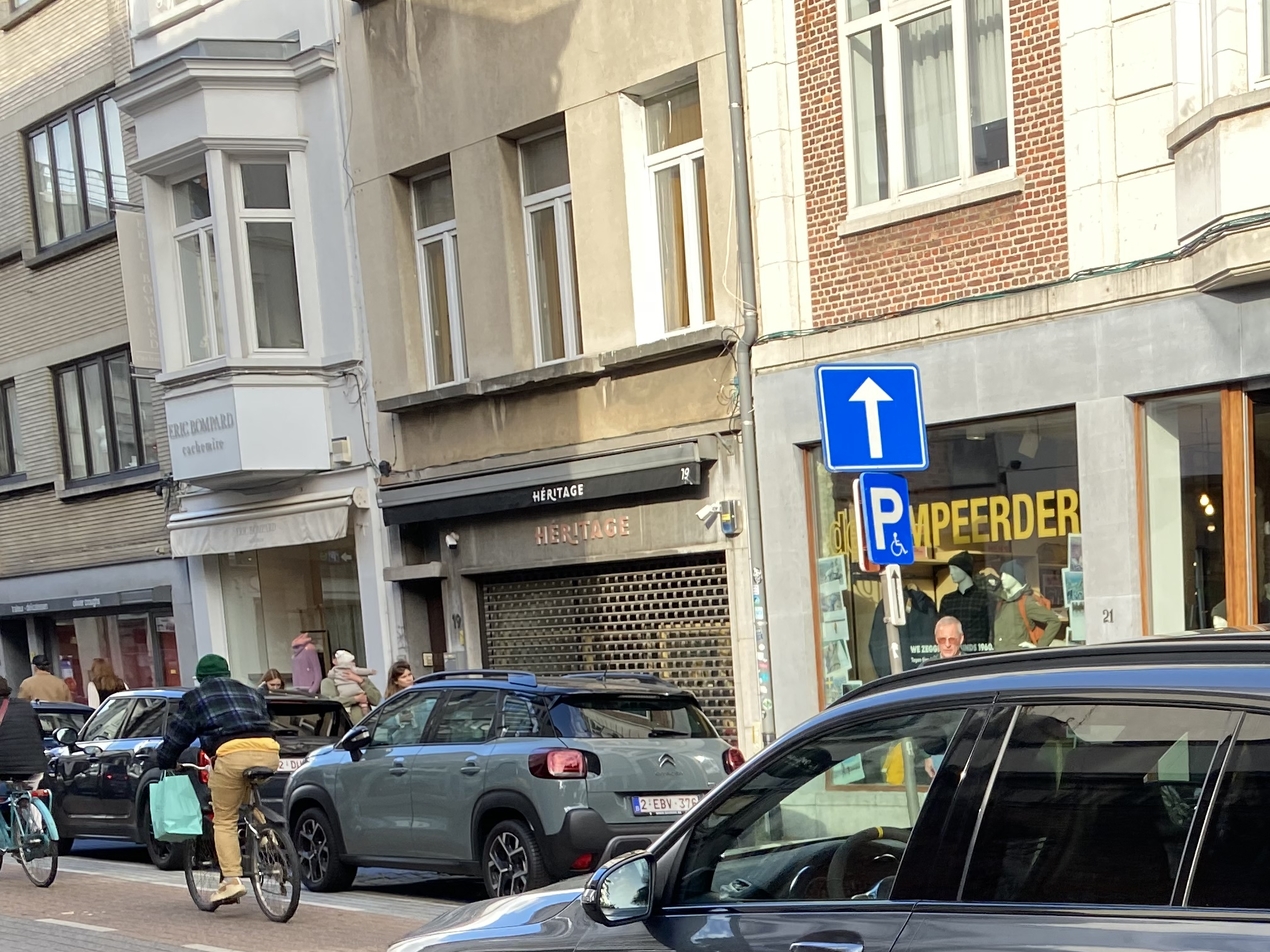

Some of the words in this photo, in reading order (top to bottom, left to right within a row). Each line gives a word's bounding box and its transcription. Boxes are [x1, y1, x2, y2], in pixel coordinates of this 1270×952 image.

[168, 420, 190, 439] ERIC
[190, 412, 234, 436] BOMPARD
[182, 439, 225, 456] cachemire
[680, 467, 691, 480] 19
[870, 487, 903, 550] P
[452, 613, 462, 629] 19
[1102, 609, 1114, 623] 21
[910, 645, 920, 654] WE
